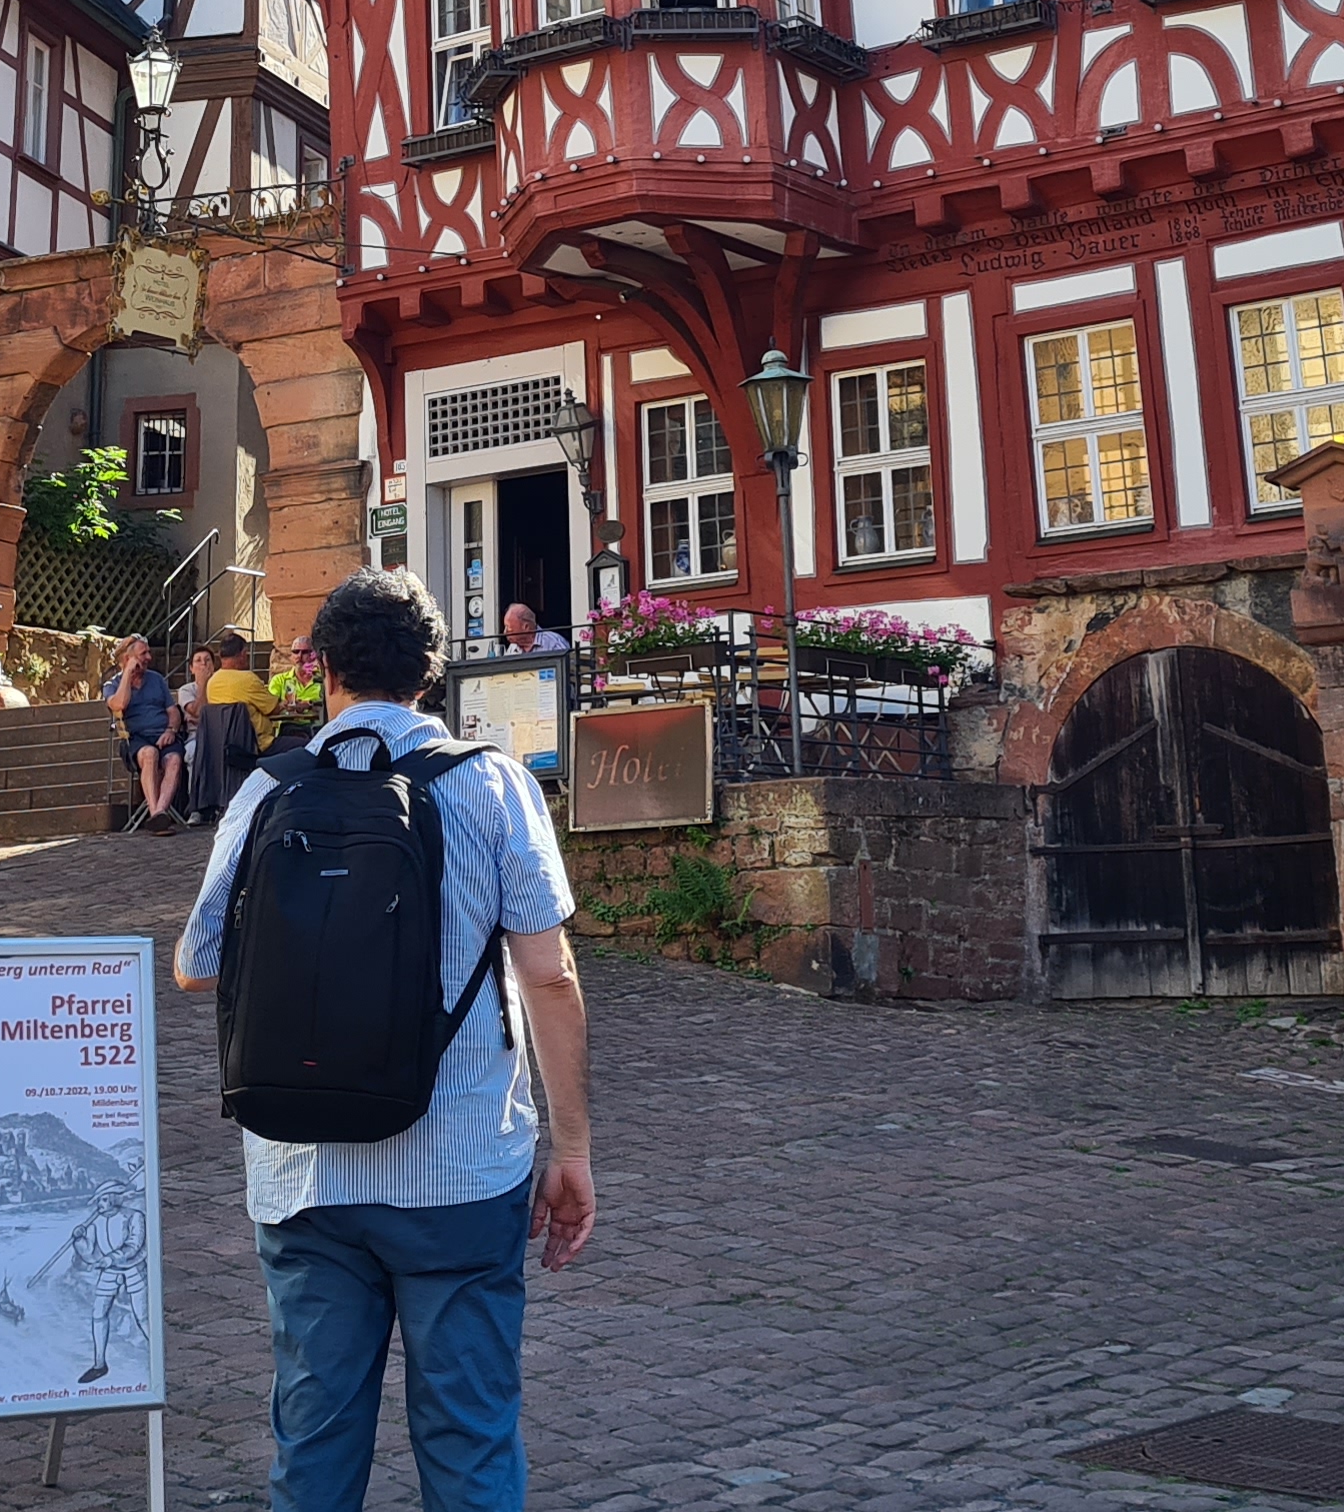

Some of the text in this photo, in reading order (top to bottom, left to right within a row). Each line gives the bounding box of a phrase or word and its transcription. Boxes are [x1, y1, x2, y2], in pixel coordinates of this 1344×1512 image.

[958, 233, 1140, 277] Ludwig Bauer
[377, 517, 405, 528] EINGANG
[28, 964, 86, 976] unterm
[51, 993, 132, 1016] Pfarrei
[0, 1018, 132, 1042] Miltenberg
[79, 1045, 136, 1066] 1522
[94, 1085, 118, 1095] 19.00
[120, 1085, 137, 1093] Uhr
